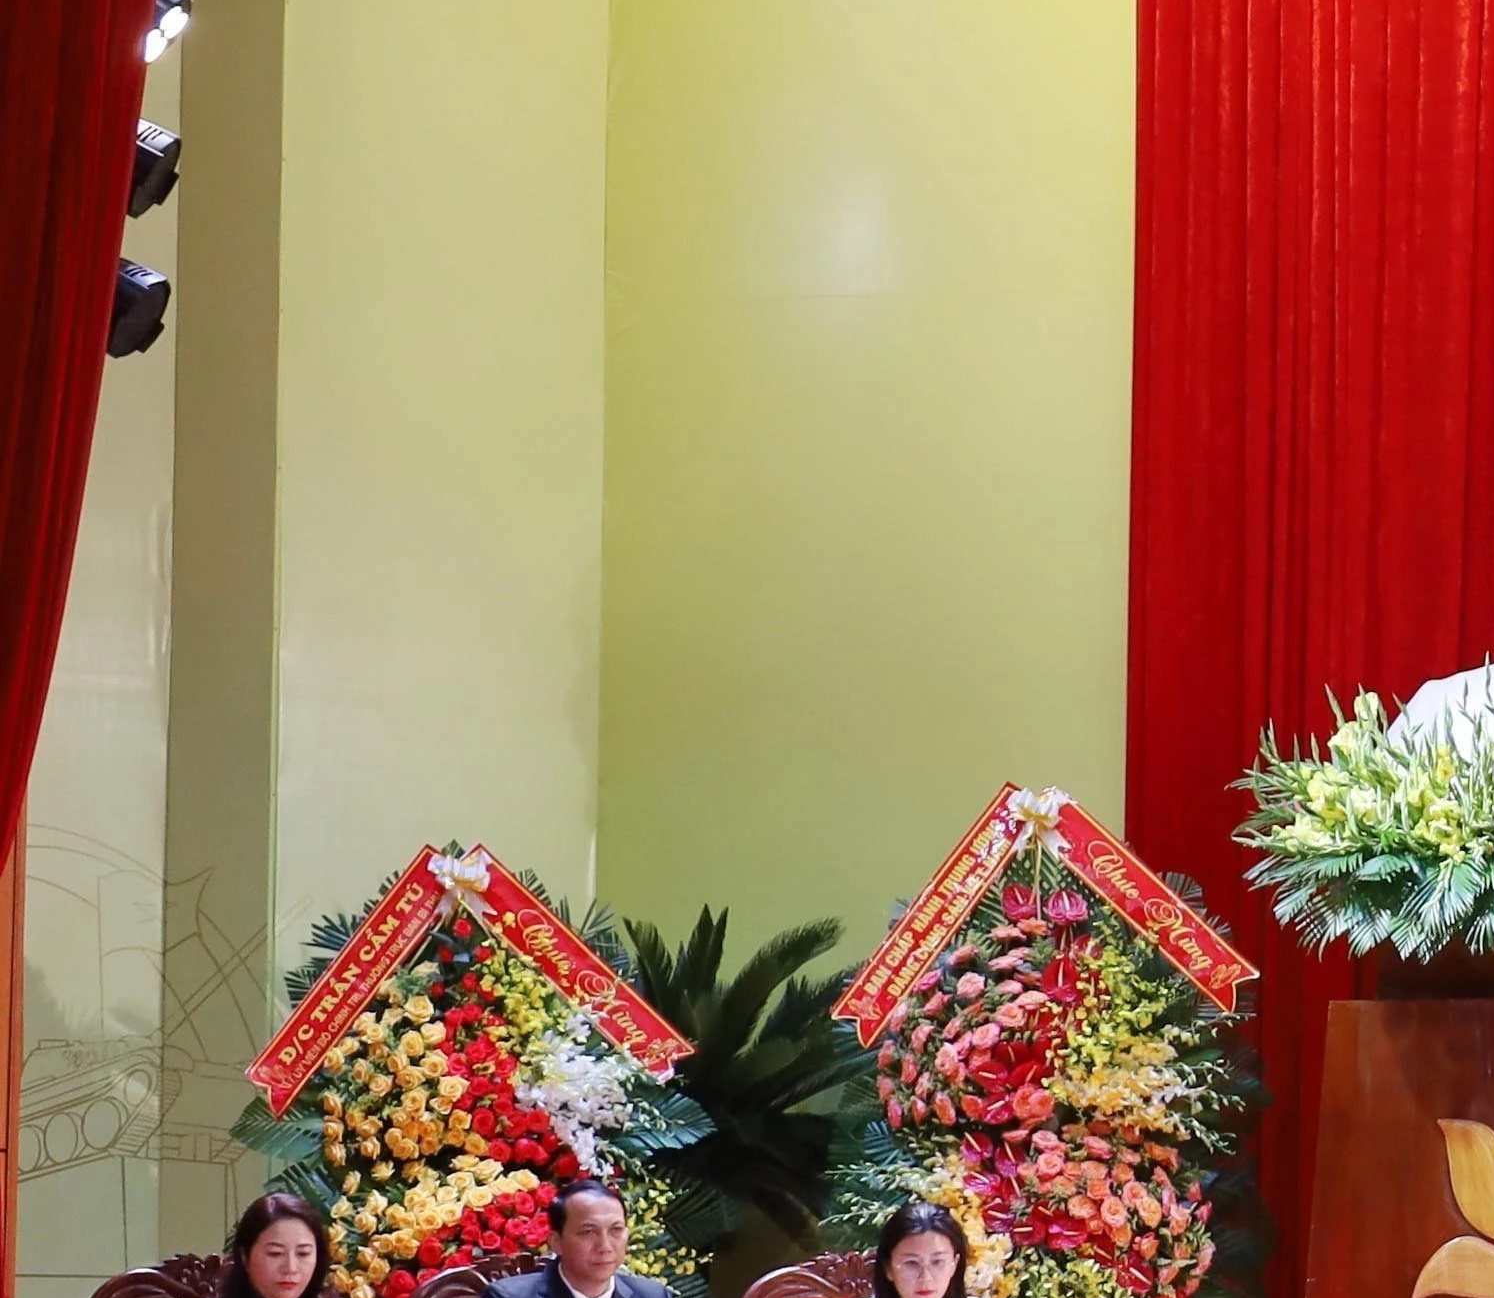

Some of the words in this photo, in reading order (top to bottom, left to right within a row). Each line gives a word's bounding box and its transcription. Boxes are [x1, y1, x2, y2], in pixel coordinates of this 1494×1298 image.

[277, 1024, 313, 1065] Đ/C
[395, 882, 423, 913] TÚ
[863, 964, 891, 995] BAN
[878, 924, 914, 967] CHẤP
[910, 894, 944, 932] HÀNH
[937, 854, 976, 899] TRUNG
